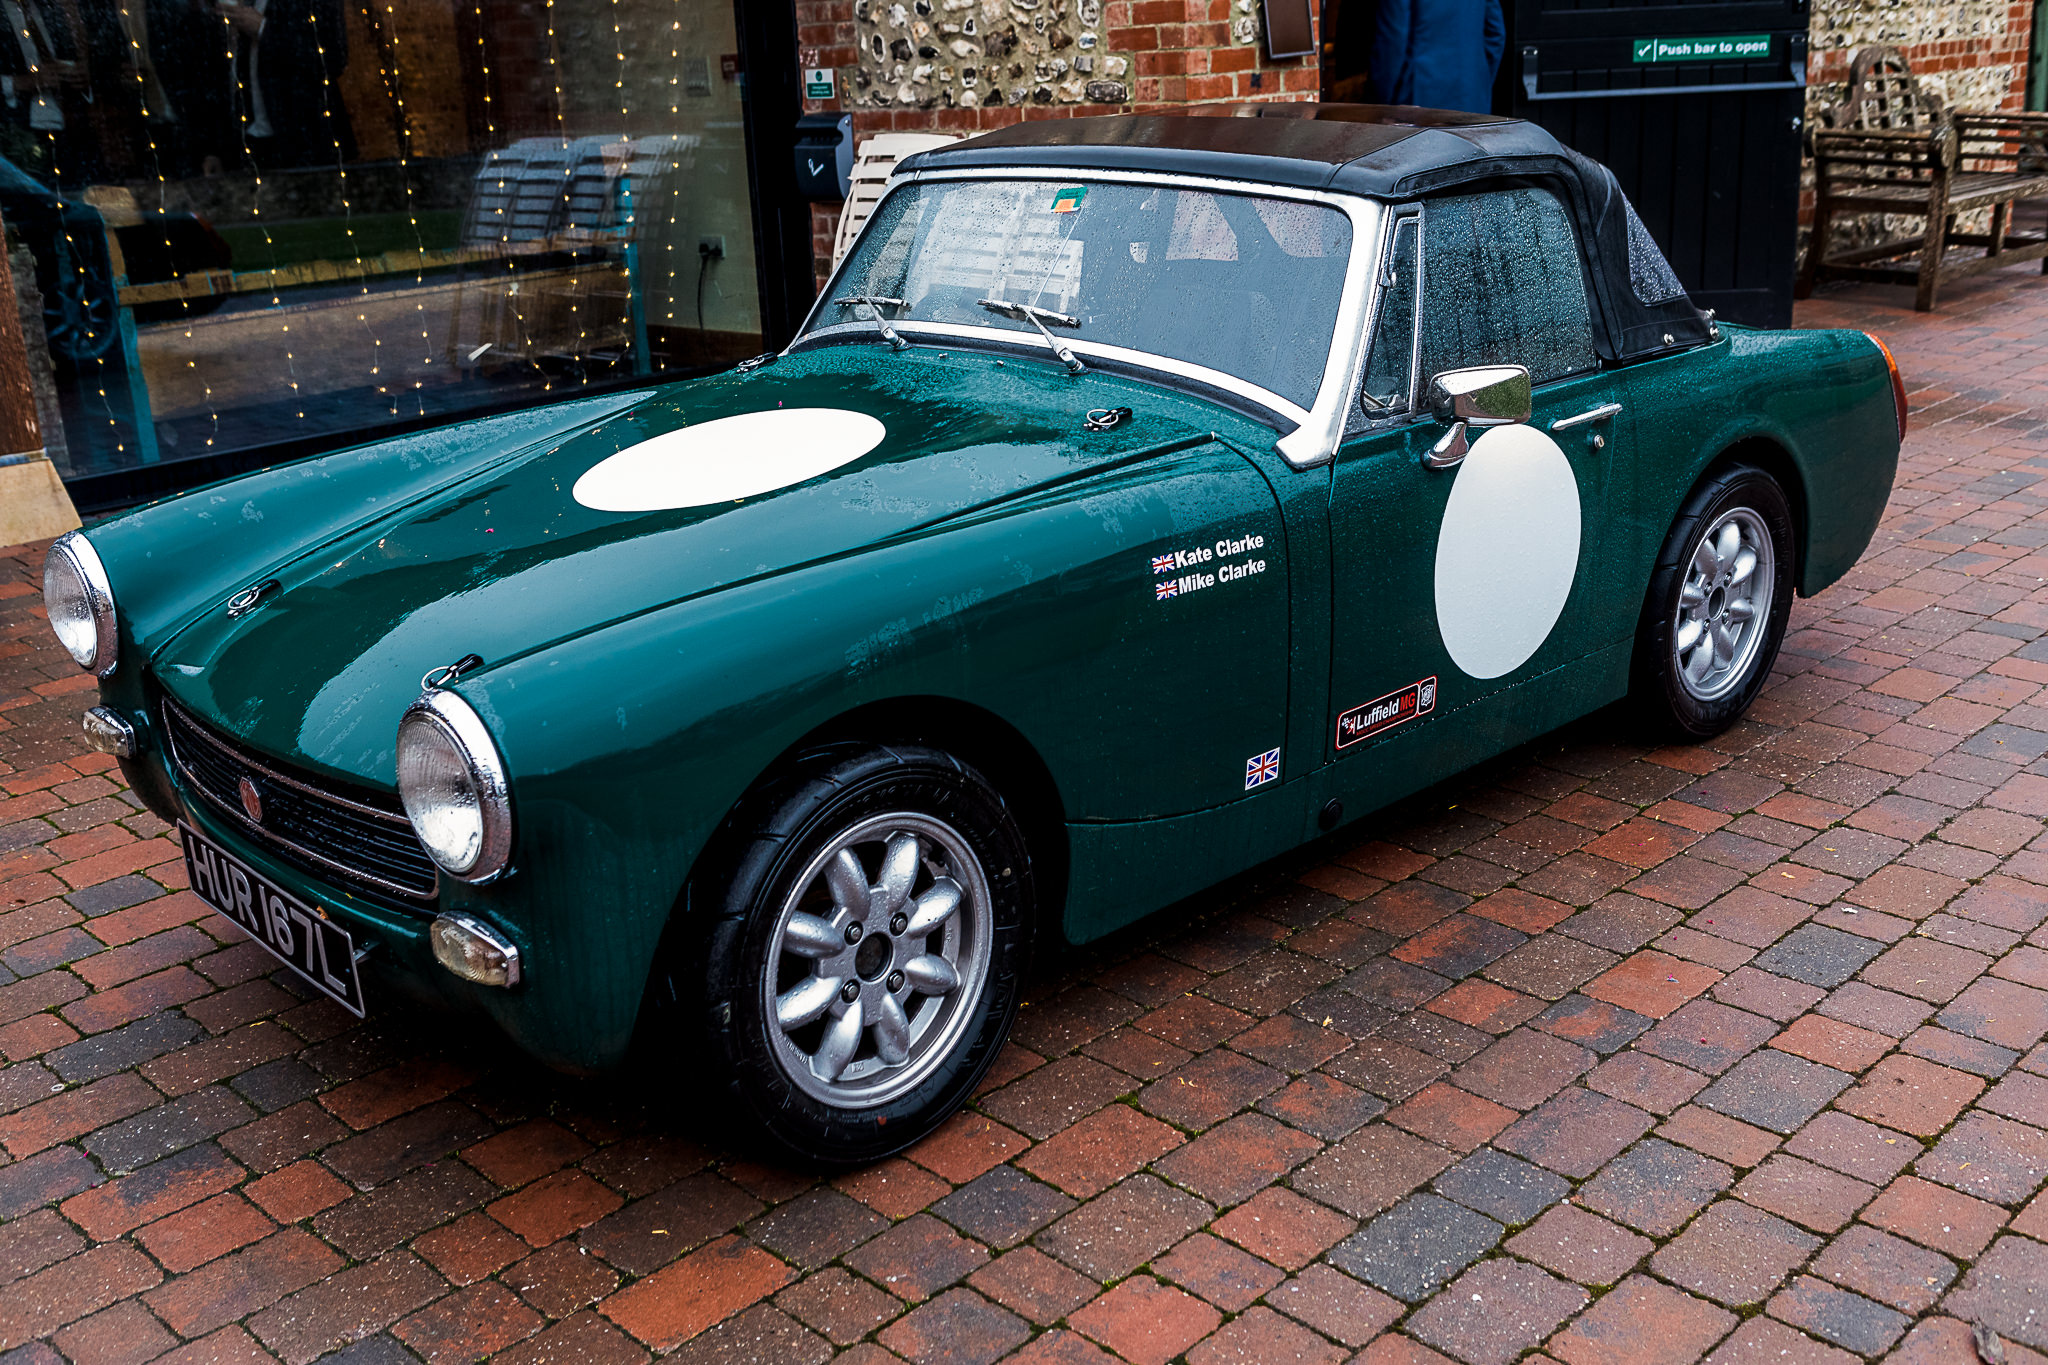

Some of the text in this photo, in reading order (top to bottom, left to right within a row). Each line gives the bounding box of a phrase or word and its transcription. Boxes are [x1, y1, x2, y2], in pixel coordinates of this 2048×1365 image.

[1659, 41, 1768, 56] Push bar to open
[1174, 534, 1264, 569] Kate Clarke
[1178, 559, 1266, 595] Mike Clarke
[188, 835, 347, 997] HUR 167L
